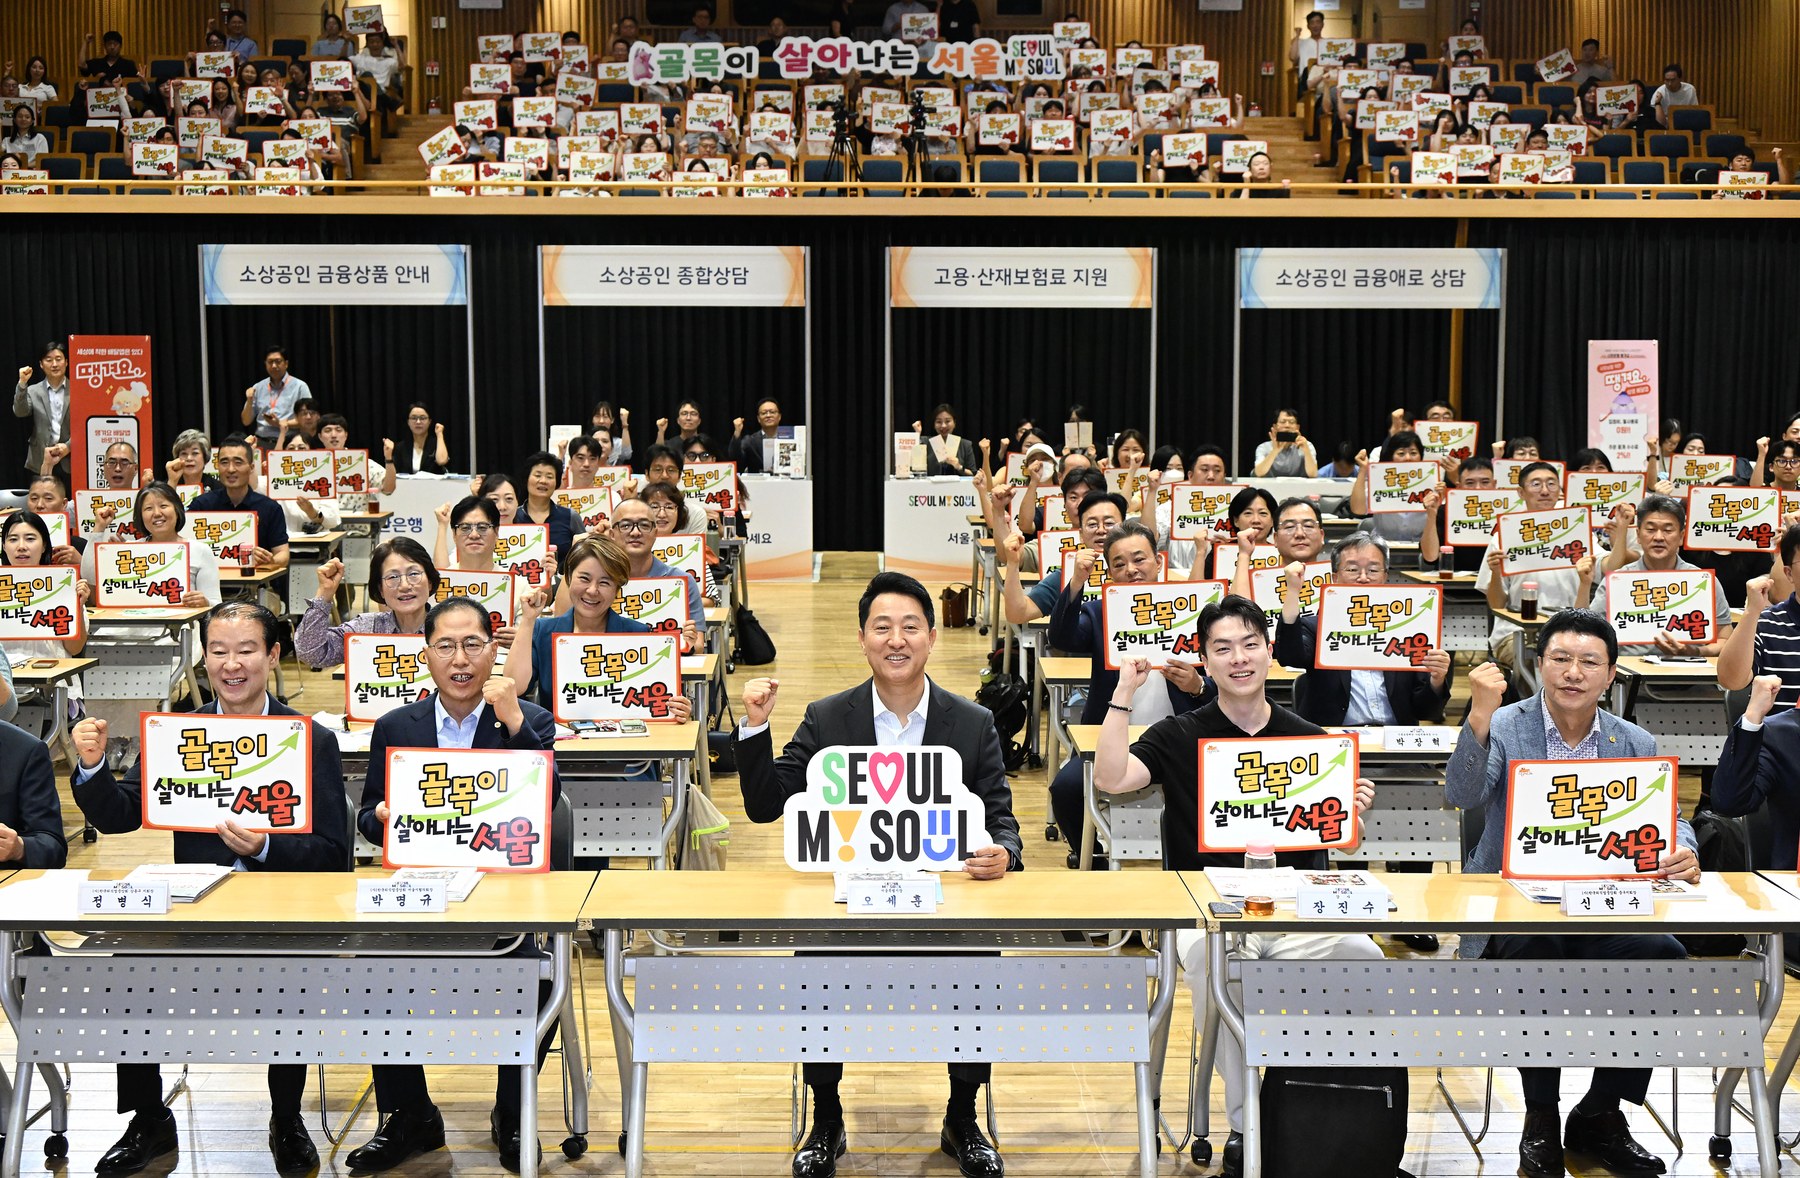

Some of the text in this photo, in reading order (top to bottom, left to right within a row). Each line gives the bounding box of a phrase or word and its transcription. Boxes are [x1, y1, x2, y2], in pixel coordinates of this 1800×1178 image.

[657, 43, 999, 78] 골목이 살아나는 서울
[239, 264, 430, 286] 소상공인 금융상품 안내
[599, 265, 749, 286] 소상공인 종합상담
[934, 267, 1108, 288] 고용·산재보험료 지원
[1275, 268, 1466, 288] 소상공인 금융애로 상담
[76, 358, 146, 388] 땡겨요
[1428, 426, 1463, 446] 골목이
[281, 456, 318, 476] 골목이
[1383, 467, 1422, 489] 골목이
[1684, 459, 1720, 479] 골목이
[271, 477, 332, 497] 살아나는 서울
[339, 473, 365, 491] 서울
[593, 472, 615, 487] 목이
[682, 468, 719, 490] 골목이
[1584, 479, 1627, 503] 골목이
[705, 489, 733, 509] 서울
[953, 495, 976, 507] SOUL
[1189, 490, 1231, 515] 골목이
[1373, 489, 1408, 502] 살아나는
[1464, 495, 1509, 520] 골목이
[1708, 494, 1760, 522] 골목이
[193, 518, 237, 543] 골목이
[1176, 515, 1216, 529] 살아나는
[1451, 520, 1492, 534] 살아나는
[1519, 516, 1568, 544] 골목이
[493, 534, 526, 559] 목이
[746, 532, 772, 545] 세요
[948, 532, 973, 545] 서울
[1692, 522, 1775, 548] 살아나는 서울
[1507, 538, 1587, 564] 살아나는 서울
[116, 549, 166, 579] 골목이
[509, 559, 544, 584] 서울
[102, 577, 183, 604] 살아나는 서울
[1630, 579, 1688, 611] 골목이
[30, 605, 73, 635] 서울
[1131, 592, 1197, 630] 골목이
[1347, 594, 1412, 632] 골목이
[1614, 609, 1709, 640] 살아나는 서울
[1112, 630, 1174, 651] 살아나는
[1326, 630, 1433, 667] 살아나는 서울
[580, 643, 648, 682] 골목이
[354, 682, 417, 704] 살아나는
[562, 682, 673, 718] 살아나는 서울
[177, 728, 267, 779] 골목이
[822, 751, 952, 805] SEOUL
[1235, 751, 1319, 799] 골목이
[419, 762, 509, 816] 골목이
[1547, 773, 1637, 826] 골목이
[153, 777, 302, 827] 살아나는 서울
[1209, 796, 1348, 843] 살아나는 서울
[393, 815, 540, 867] 살아나는 서울
[870, 809, 975, 862] SOUL
[1517, 823, 1667, 873] 살아나는 서울
